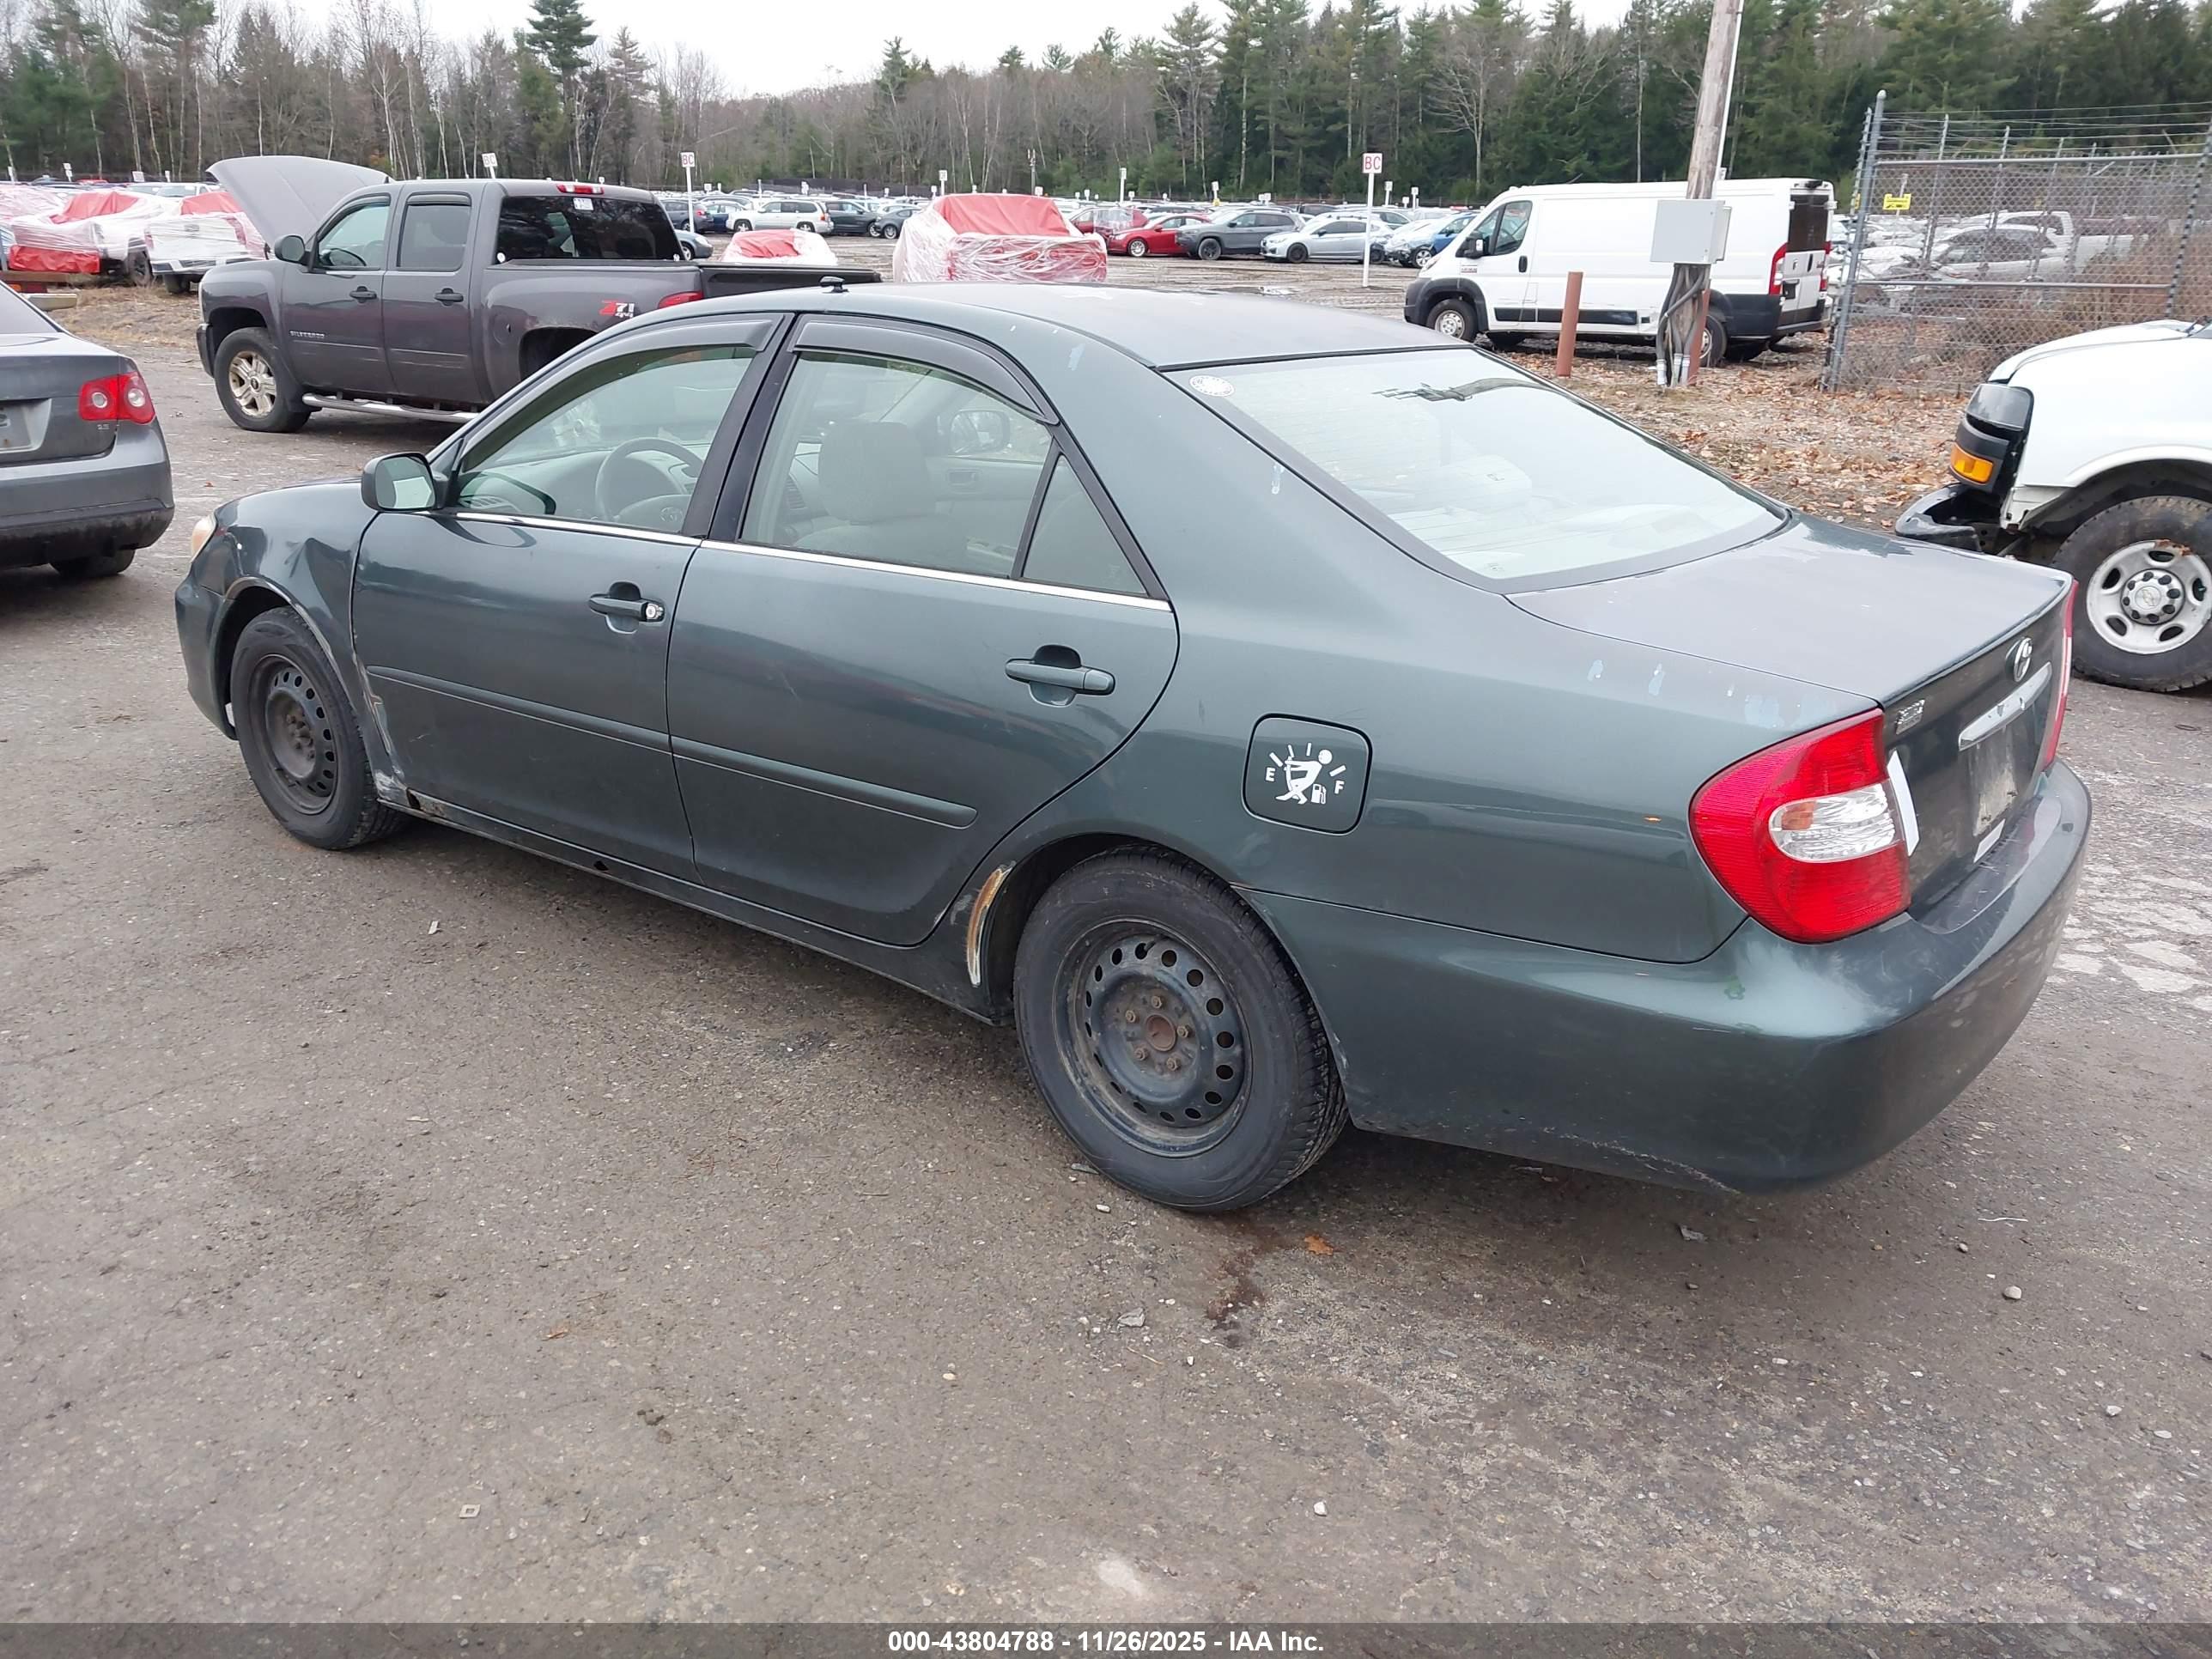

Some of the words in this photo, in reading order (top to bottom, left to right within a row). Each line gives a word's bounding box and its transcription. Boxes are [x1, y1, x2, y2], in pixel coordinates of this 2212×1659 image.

[483, 155, 495, 165] BC
[682, 155, 694, 165] BC
[1364, 156, 1381, 170] BC
[1265, 767, 1276, 782] E
[1334, 780, 1346, 794] F
